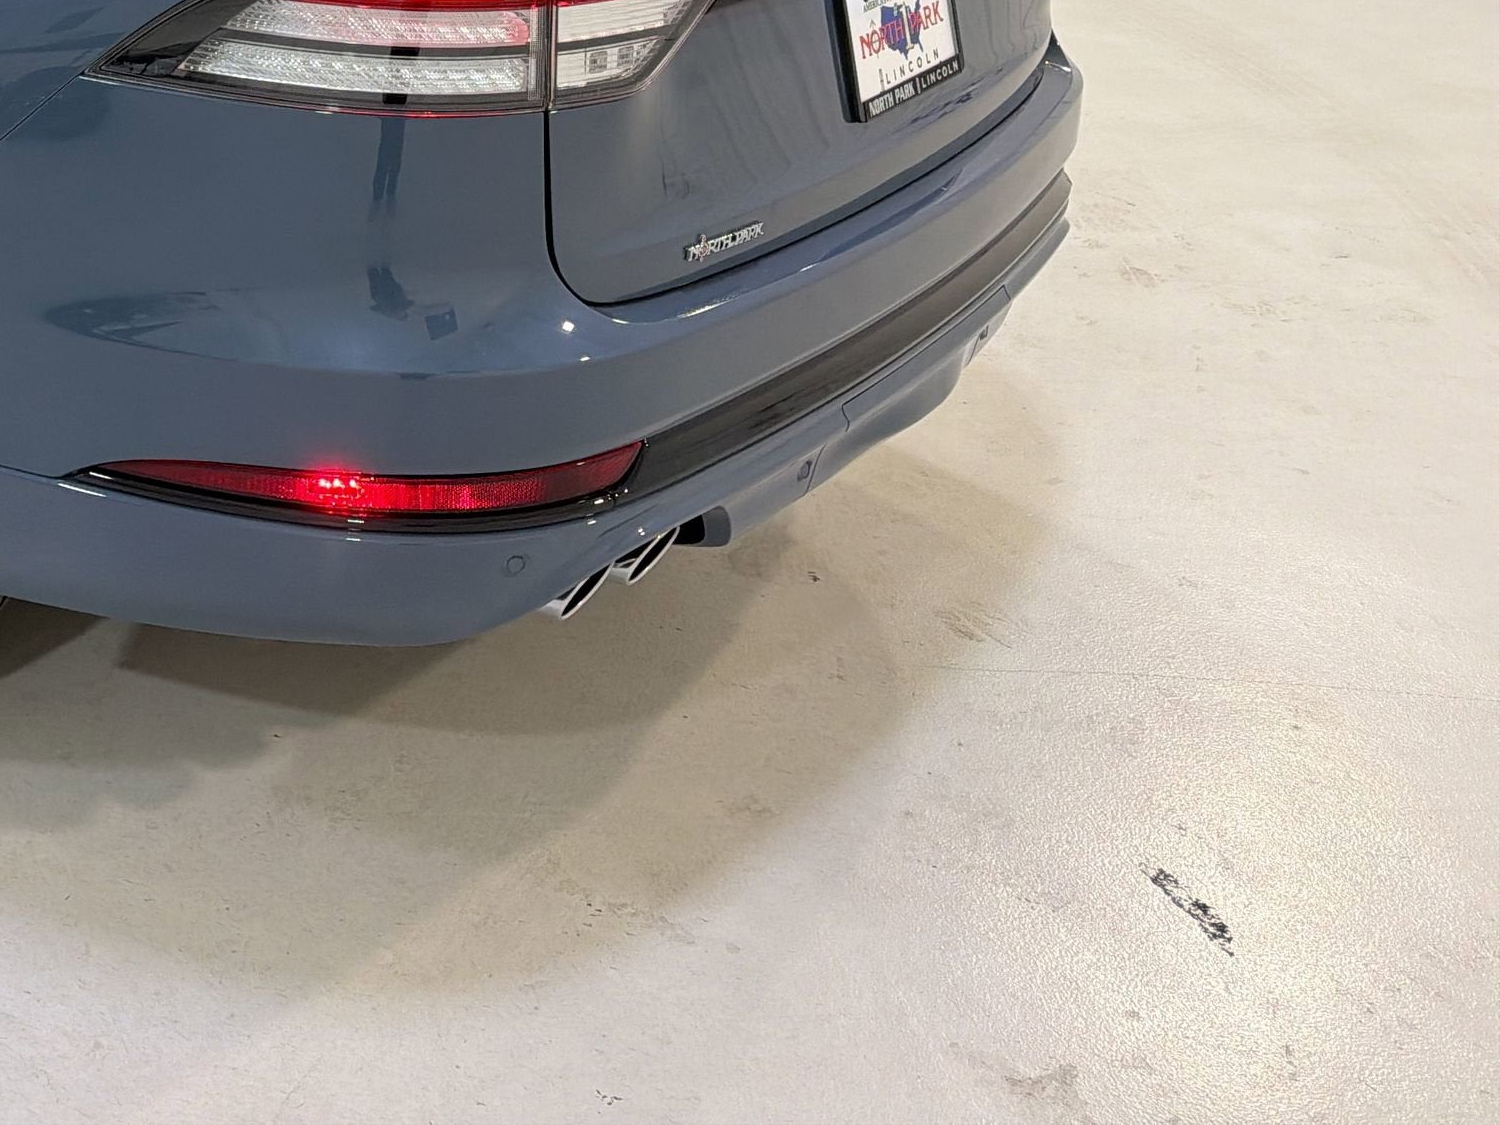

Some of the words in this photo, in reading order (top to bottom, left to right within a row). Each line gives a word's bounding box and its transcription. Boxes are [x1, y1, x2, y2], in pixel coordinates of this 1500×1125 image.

[859, 18, 905, 59] NORTH
[908, 0, 944, 35] PARK
[868, 92, 894, 118] NORTH
[894, 81, 916, 104] PARK
[921, 59, 959, 89] LINCOLN
[885, 47, 940, 85] LINCOLN
[688, 233, 734, 263] NORTH
[734, 222, 764, 246] PARK
